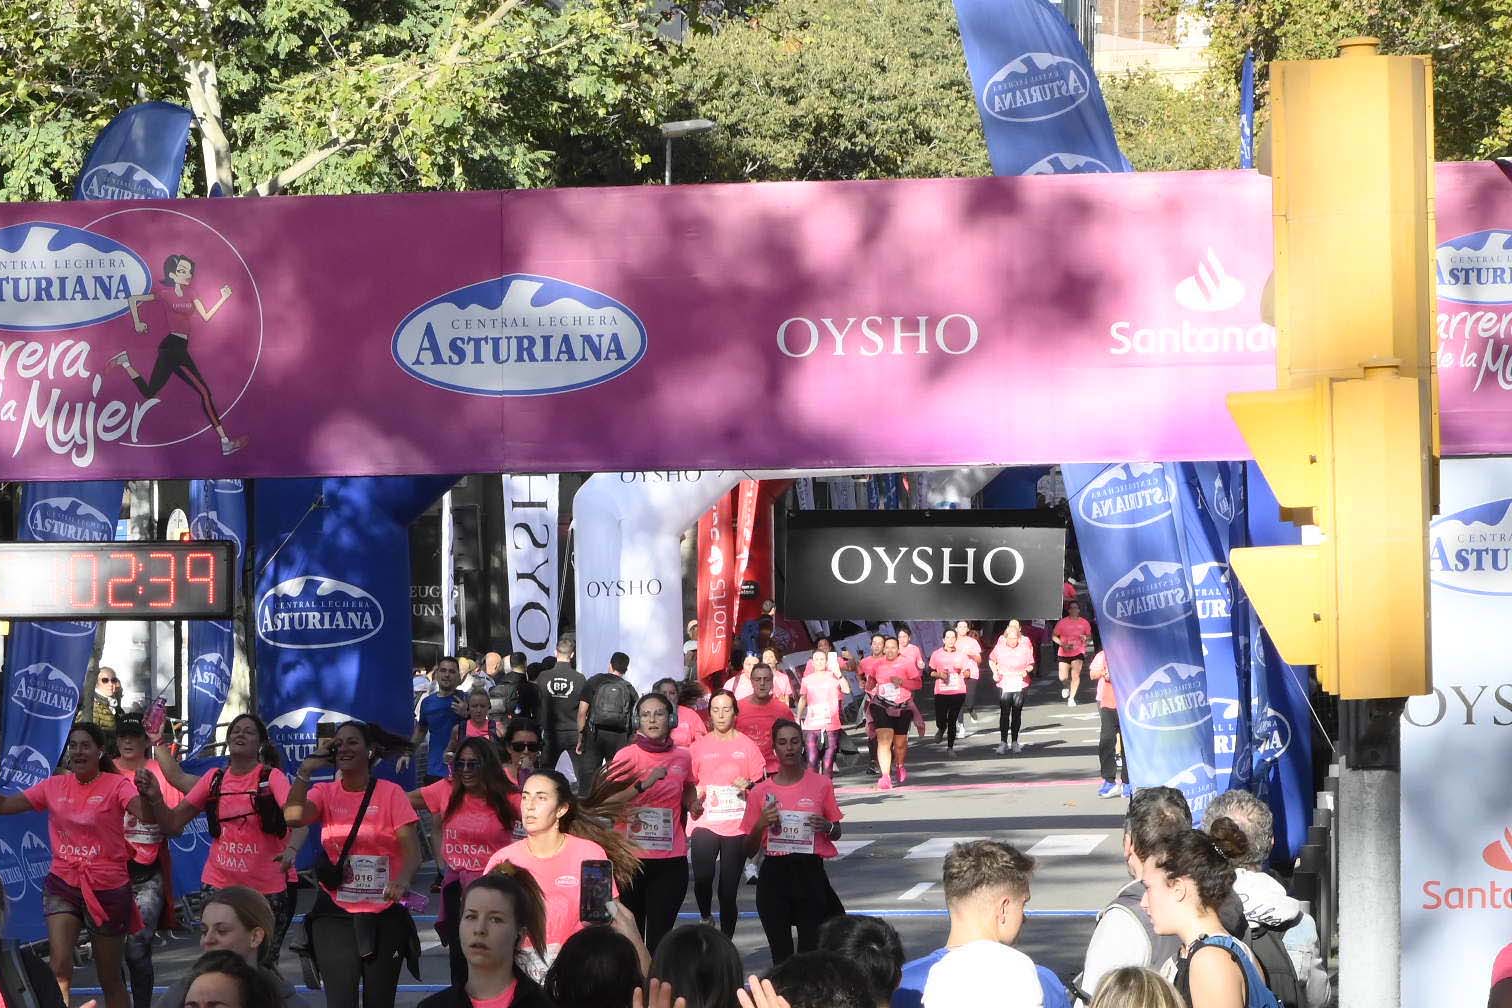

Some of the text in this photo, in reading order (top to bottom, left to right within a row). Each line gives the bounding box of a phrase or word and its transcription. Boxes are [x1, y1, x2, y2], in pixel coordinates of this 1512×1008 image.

[54, 258, 127, 270] LECHERA
[450, 315, 620, 331] CENTRAL LECHERA
[776, 313, 979, 358] OYSHO
[411, 322, 628, 366] ASTURIANA
[1459, 339, 1477, 368] la
[12, 374, 161, 468] Mujer
[831, 545, 1025, 586] OYSHO
[587, 578, 662, 598] OYSHO
[262, 606, 375, 632] ASTURIANA
[553, 681, 568, 692] BP
[354, 873, 373, 882] 016
